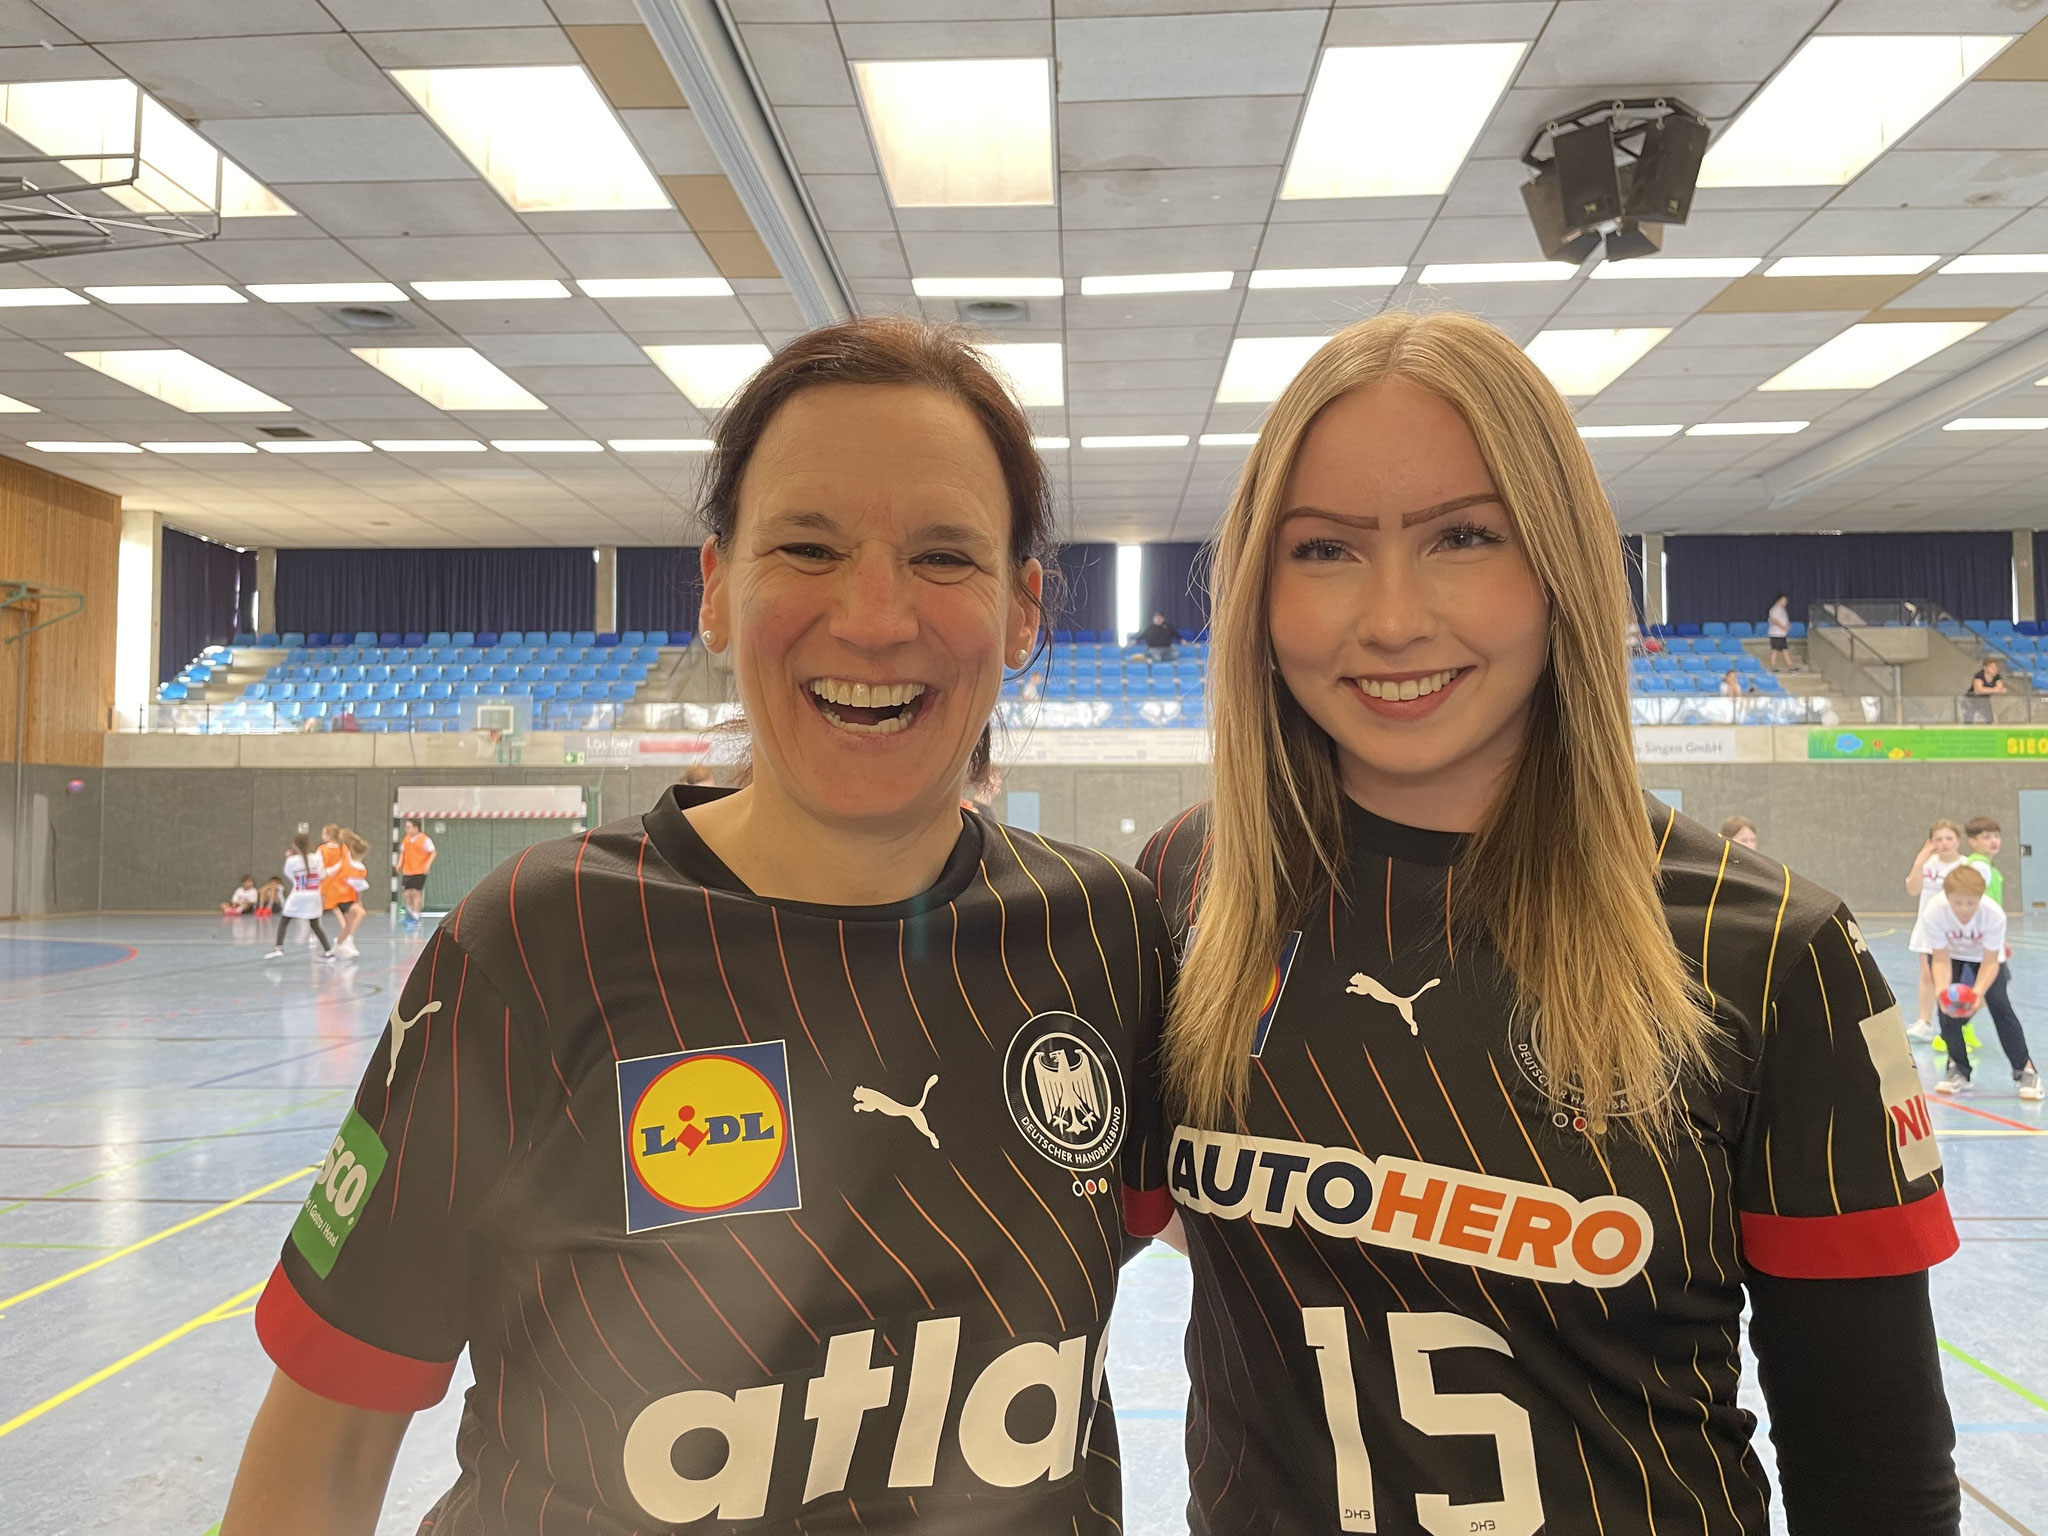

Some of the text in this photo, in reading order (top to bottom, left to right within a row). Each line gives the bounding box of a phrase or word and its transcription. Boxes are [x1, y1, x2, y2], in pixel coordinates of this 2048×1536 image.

[1021, 1106, 1121, 1164] DEUTSCHER HANDBALLBUND
[1172, 1138, 1643, 1276] AUTOHERO
[1301, 1306, 1546, 1536] 15
[1343, 1508, 1372, 1520] DHB
[1469, 1519, 1497, 1533] DHB
